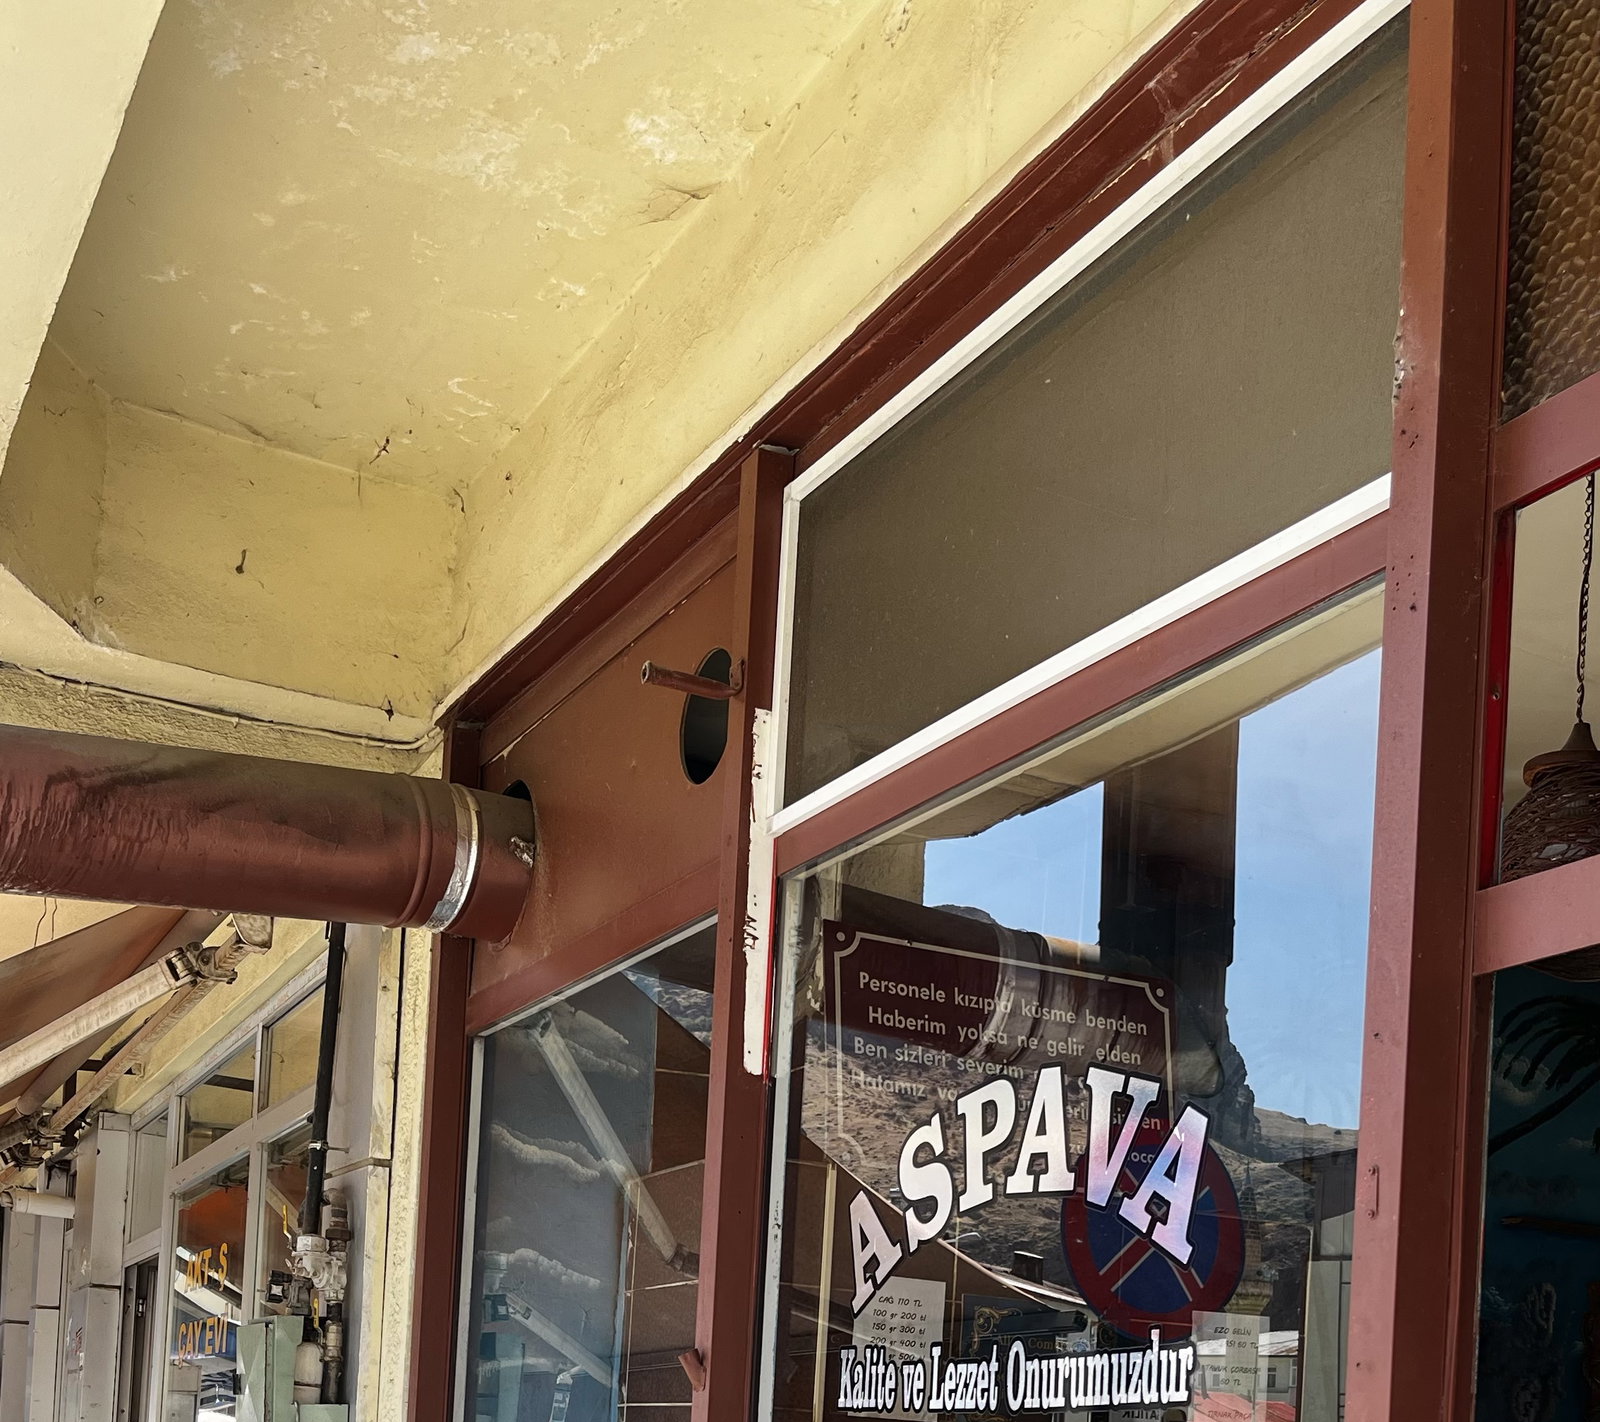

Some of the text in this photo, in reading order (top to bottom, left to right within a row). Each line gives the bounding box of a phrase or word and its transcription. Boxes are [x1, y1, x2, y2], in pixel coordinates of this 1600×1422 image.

[859, 971, 946, 1003] Personele
[1021, 998, 1077, 1024] küsme
[1086, 1009, 1147, 1036] benden
[868, 1005, 1141, 1066] Haberim yoksa ne gelir elden
[854, 1037, 1024, 1080] Ben sizleri severim
[850, 1068, 927, 1098] Hatamız
[848, 1064, 1212, 1319] ASPAVA
[184, 1242, 229, 1294] AKTŞ
[872, 1308, 888, 1317] 100
[889, 1312, 898, 1320] gr
[900, 1311, 917, 1321] 200
[897, 1298, 910, 1306] 110
[913, 1299, 923, 1307] TL
[177, 1319, 203, 1370] ÇAY
[869, 1336, 887, 1345] 200
[899, 1339, 917, 1348] 400
[871, 1322, 887, 1331] 150
[899, 1325, 916, 1334] 300
[918, 1327, 926, 1335] tl
[1213, 1326, 1252, 1336] EZO GELİN
[838, 1324, 1196, 1415] Kalite ve Lezzet Onurumuzdur
[898, 1352, 916, 1361] 500
